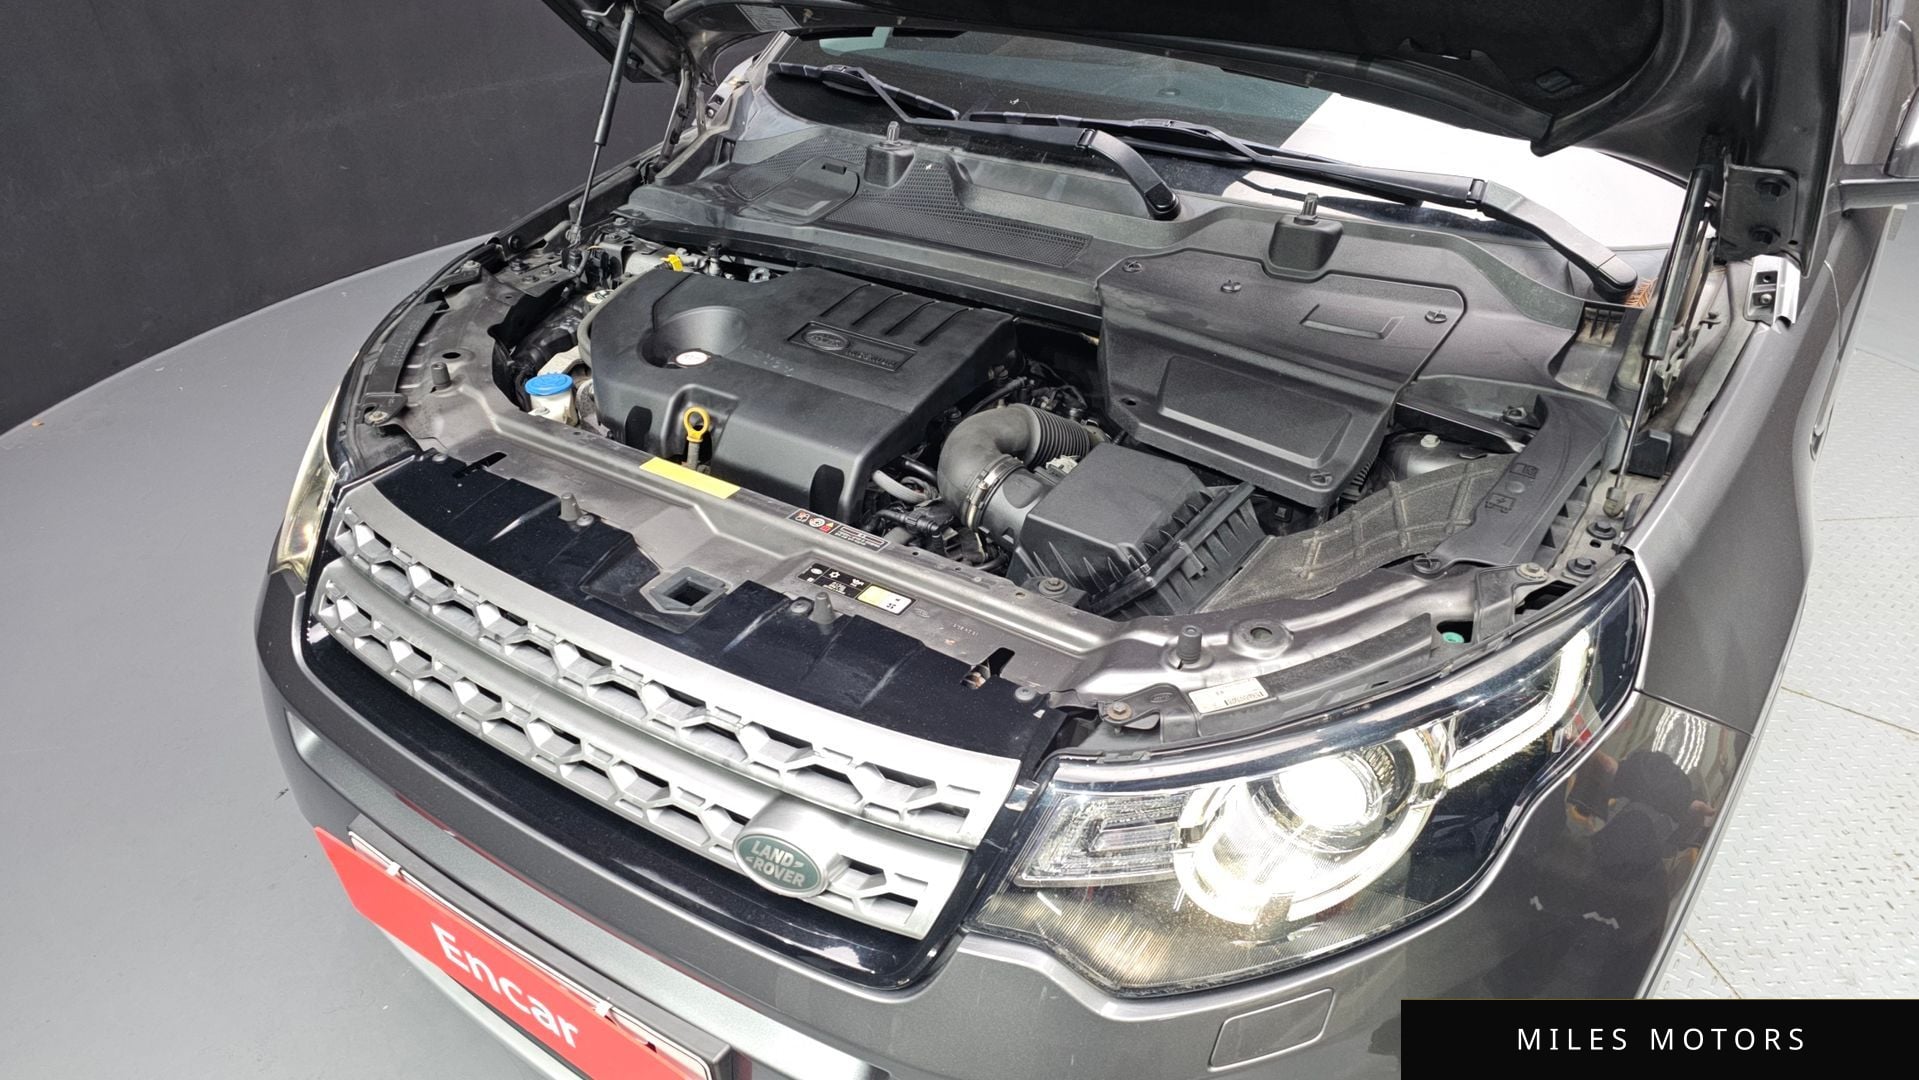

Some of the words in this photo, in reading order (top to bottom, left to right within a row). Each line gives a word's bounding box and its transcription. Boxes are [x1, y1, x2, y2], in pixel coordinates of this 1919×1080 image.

[751, 840, 795, 868] LAND
[753, 857, 806, 887] ROVER
[430, 921, 579, 1049] Encar
